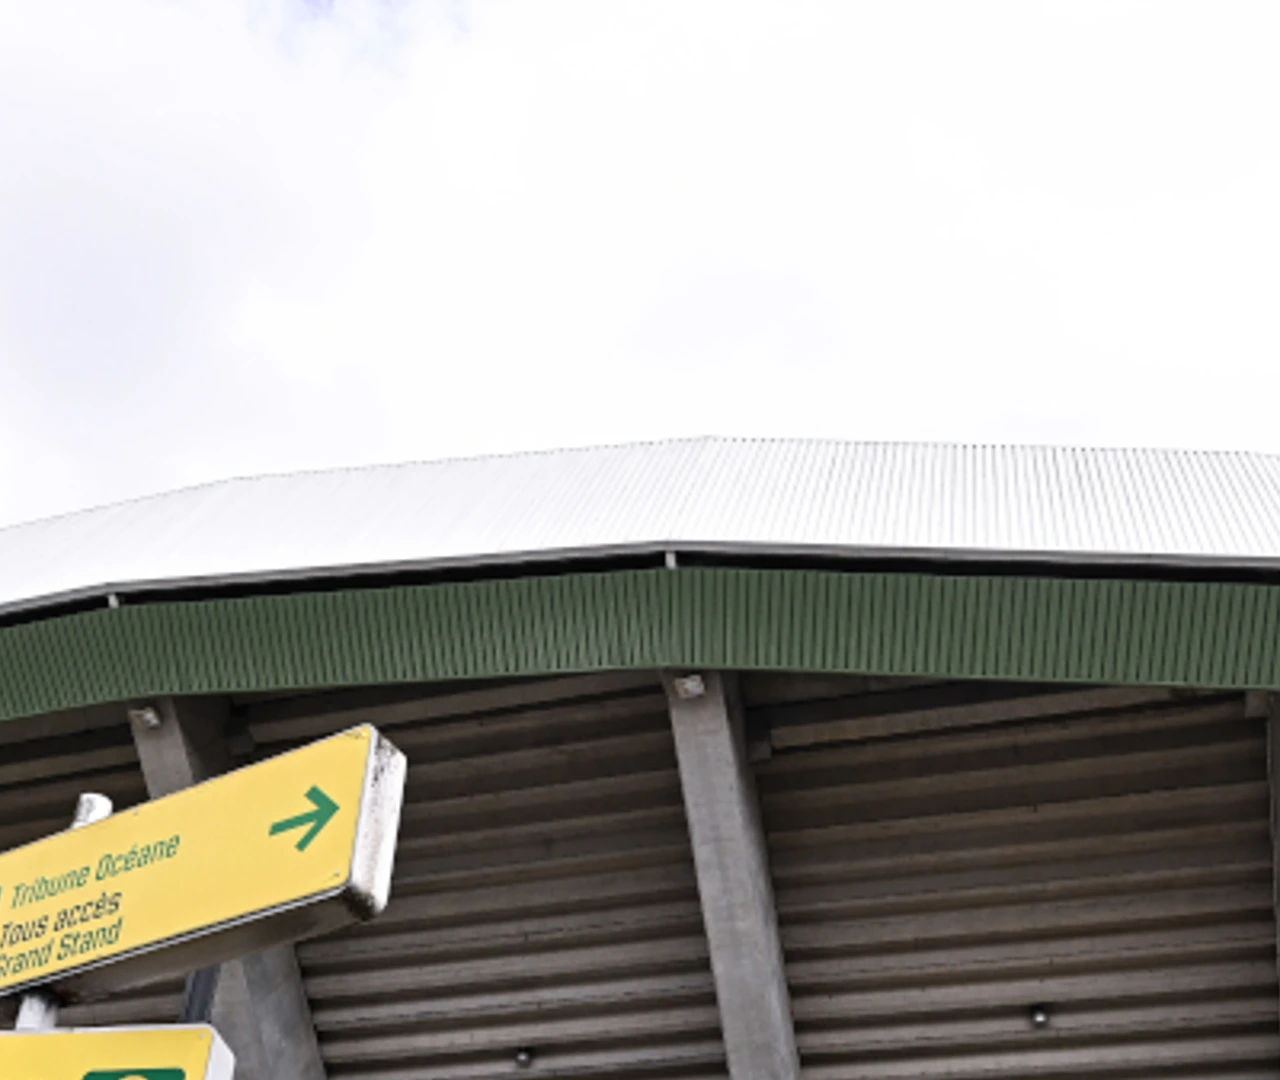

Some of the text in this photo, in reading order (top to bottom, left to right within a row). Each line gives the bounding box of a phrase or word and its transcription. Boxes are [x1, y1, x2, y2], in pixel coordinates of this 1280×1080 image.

[12, 835, 180, 908] Tribune Océane
[0, 914, 49, 948] Tous
[57, 916, 123, 960] Stand
